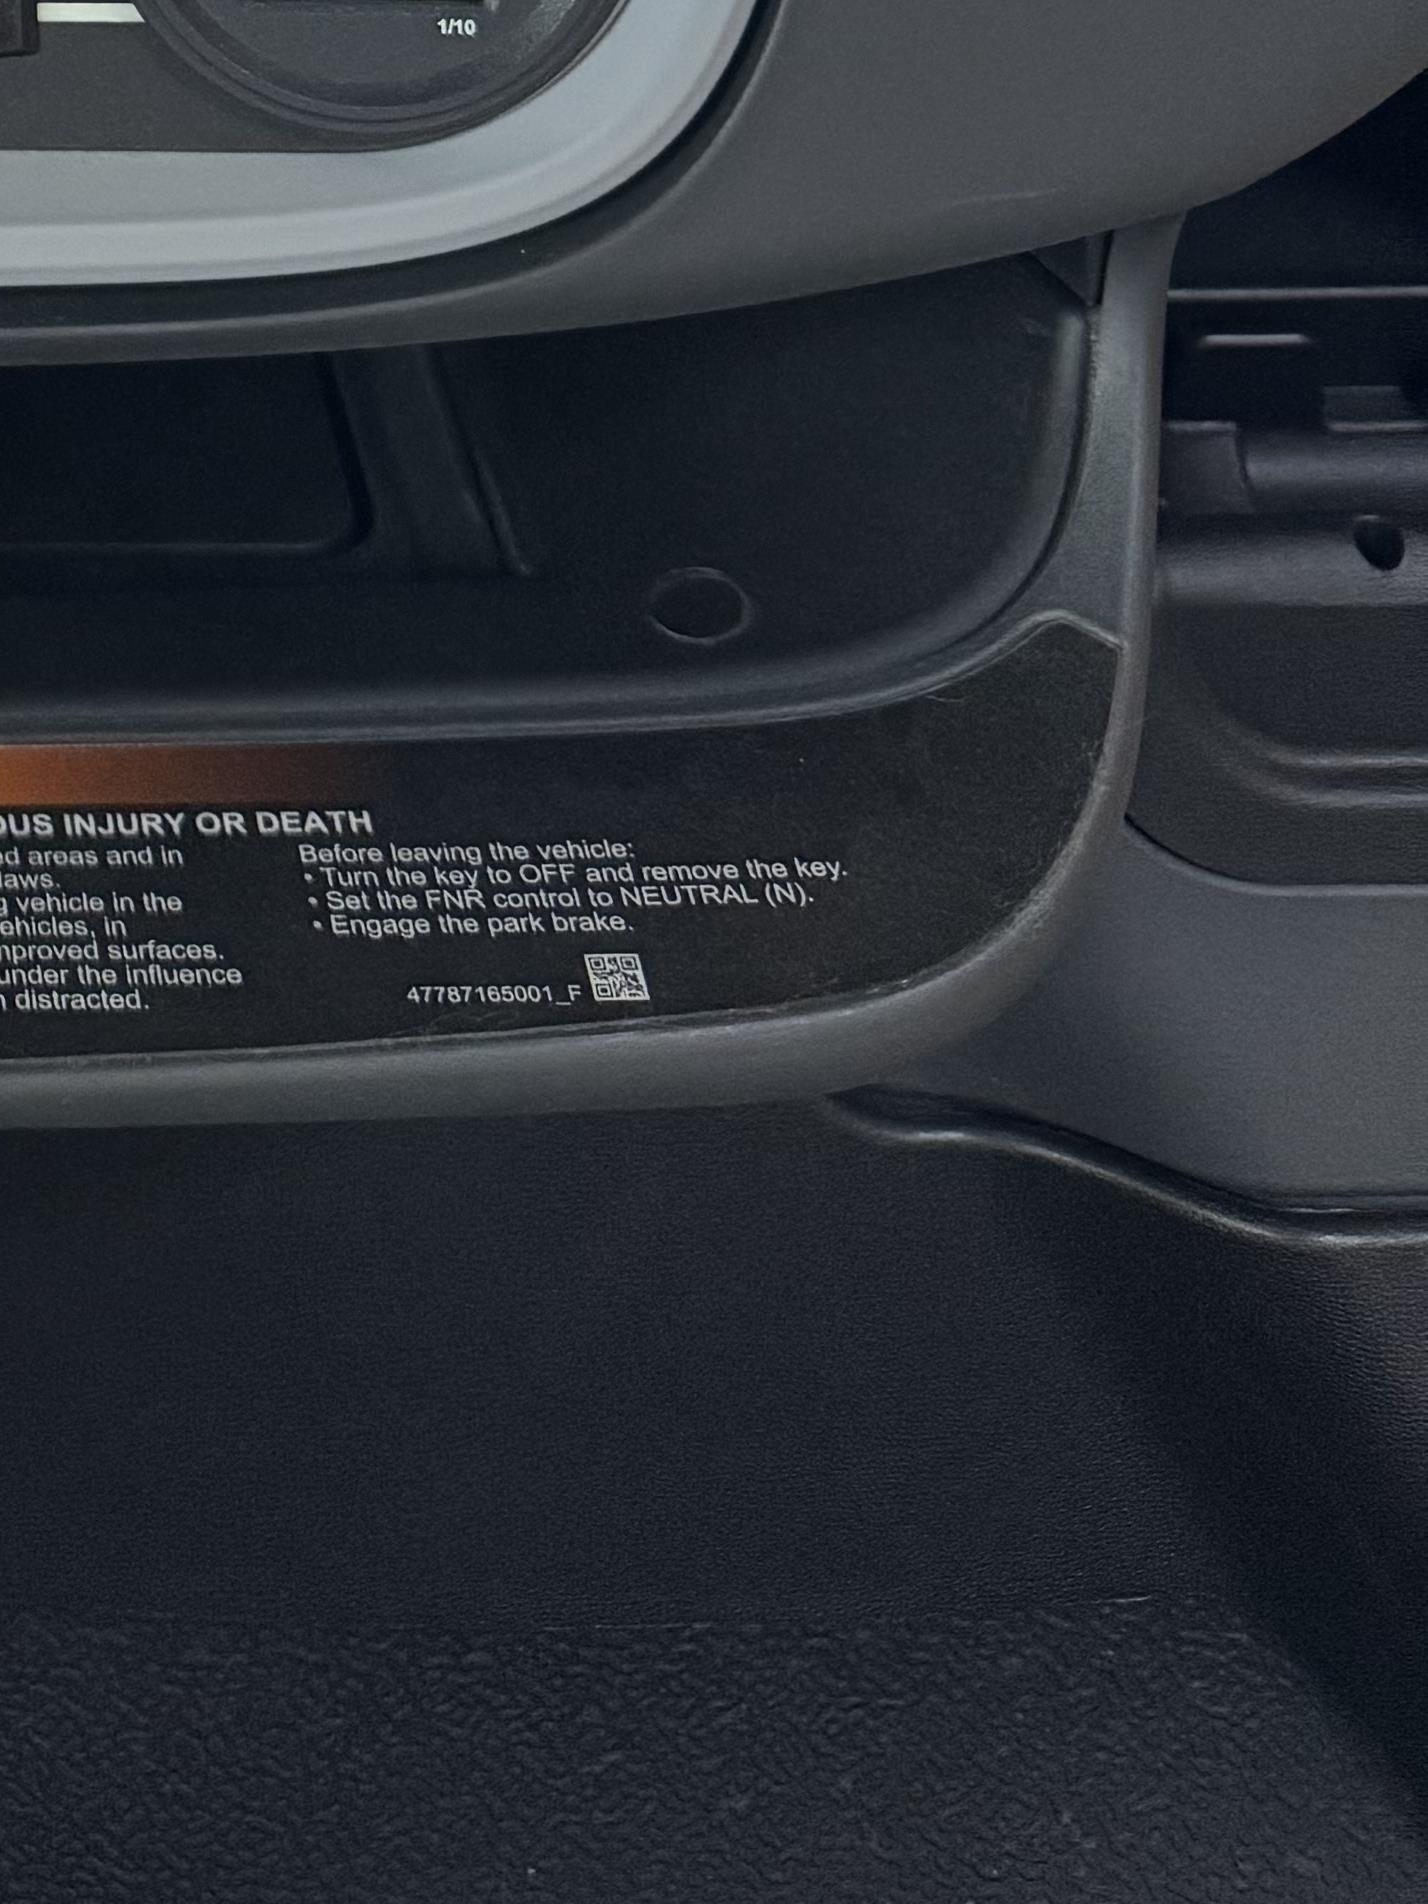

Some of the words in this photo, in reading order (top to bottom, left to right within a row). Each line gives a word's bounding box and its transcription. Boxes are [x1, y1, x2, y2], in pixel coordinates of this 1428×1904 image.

[436, 18, 477, 37] 1/10
[63, 811, 184, 836] INJURY
[195, 811, 246, 835] OR
[256, 809, 372, 835] DEATH
[28, 851, 98, 866] areas
[106, 846, 153, 866] and
[161, 846, 183, 866] in
[298, 844, 383, 864] Before
[390, 842, 482, 868] leaving
[488, 842, 529, 862] the
[536, 841, 634, 862] vehicle:
[319, 865, 379, 886] Turn
[385, 865, 426, 885] the
[433, 864, 477, 890] key
[486, 864, 511, 884] to
[518, 863, 574, 884] OFF
[585, 862, 634, 883] and
[641, 865, 739, 882] remove
[745, 860, 788, 881] the
[794, 860, 847, 885] key.
[15, 894, 104, 914] vehicle
[112, 894, 135, 914] in
[142, 894, 182, 914] the
[325, 890, 370, 911] Set
[376, 890, 417, 910] the
[425, 889, 485, 910] FNR
[492, 888, 580, 909] control
[587, 887, 613, 908] to
[620, 885, 758, 907] NEUTRAL
[764, 885, 813, 910] (N).
[330, 914, 430, 940] Engage
[437, 914, 479, 934] the
[487, 913, 545, 938] park
[551, 912, 633, 933] brake.
